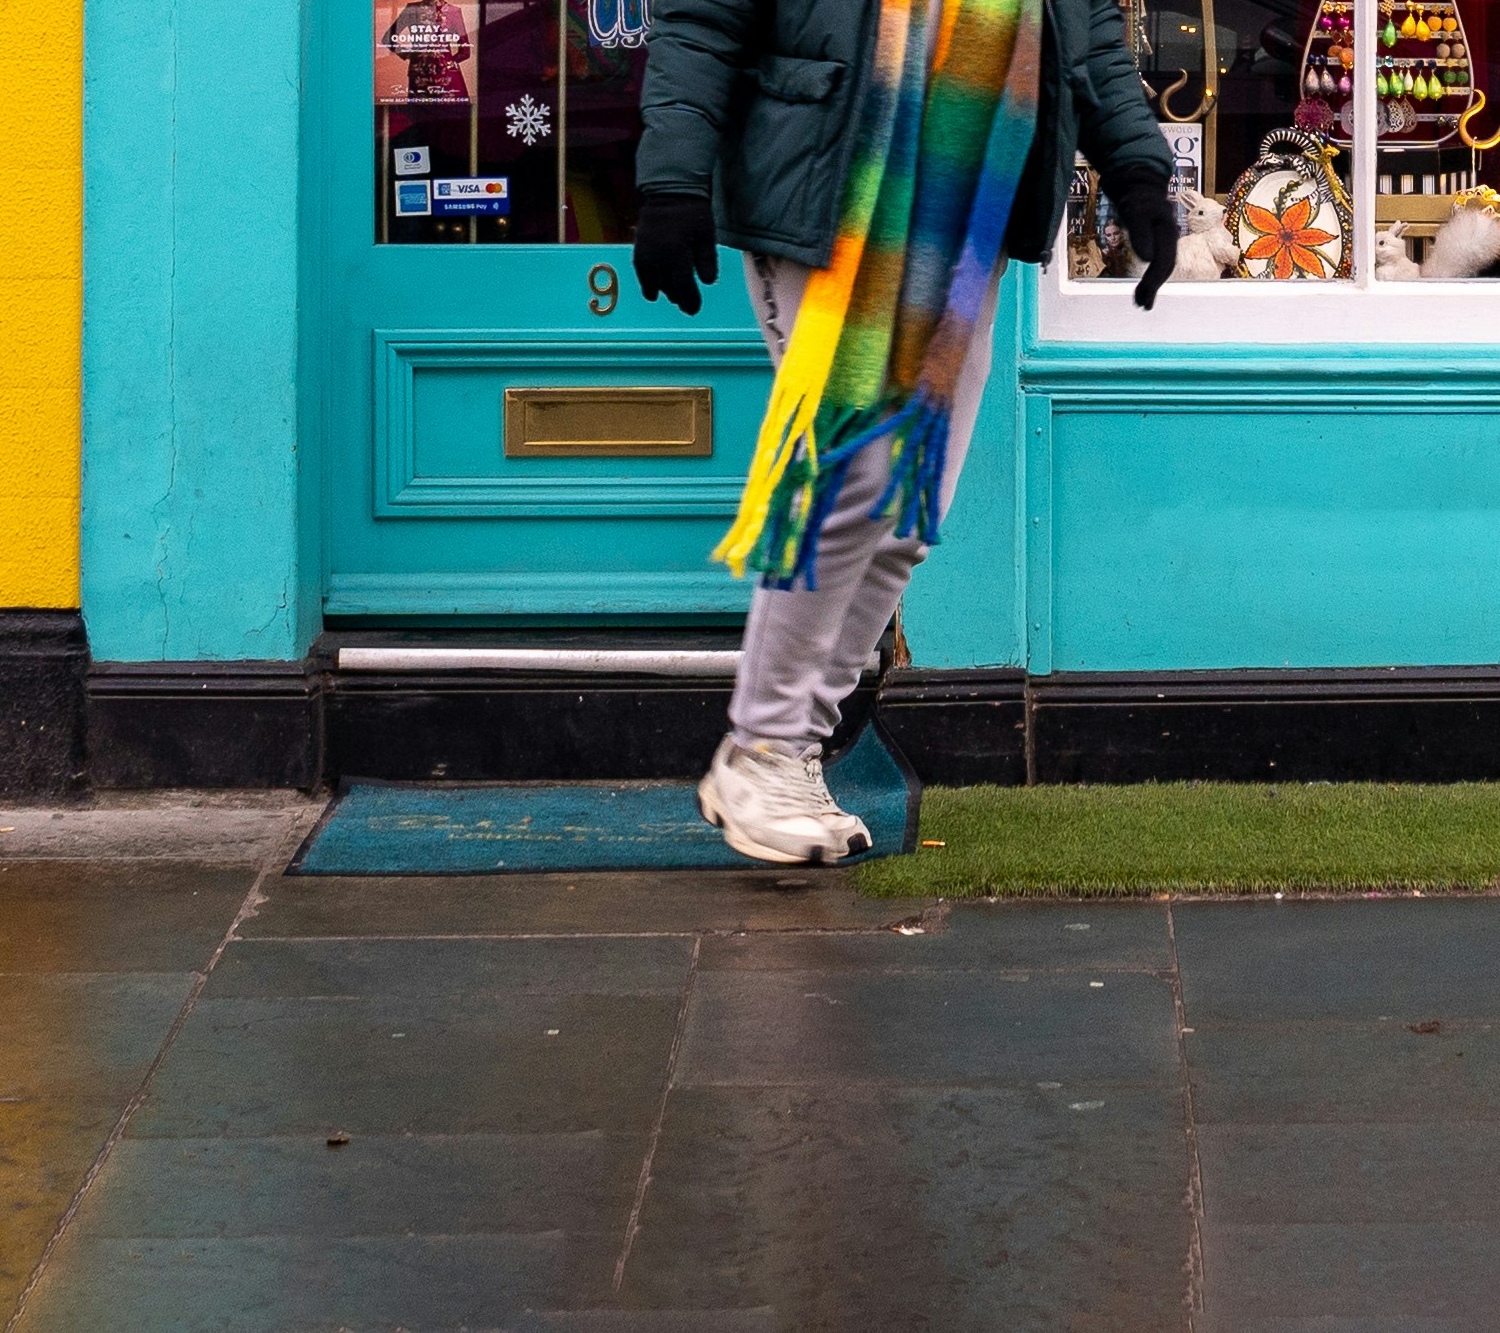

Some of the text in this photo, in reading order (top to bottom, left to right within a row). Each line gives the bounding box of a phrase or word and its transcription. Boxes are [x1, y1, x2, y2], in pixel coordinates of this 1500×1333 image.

[410, 24, 440, 34] STAY
[390, 33, 461, 43] CONNECTED
[1161, 126, 1193, 134] SWOLD
[457, 184, 481, 194] VISA
[588, 263, 619, 316] 9
